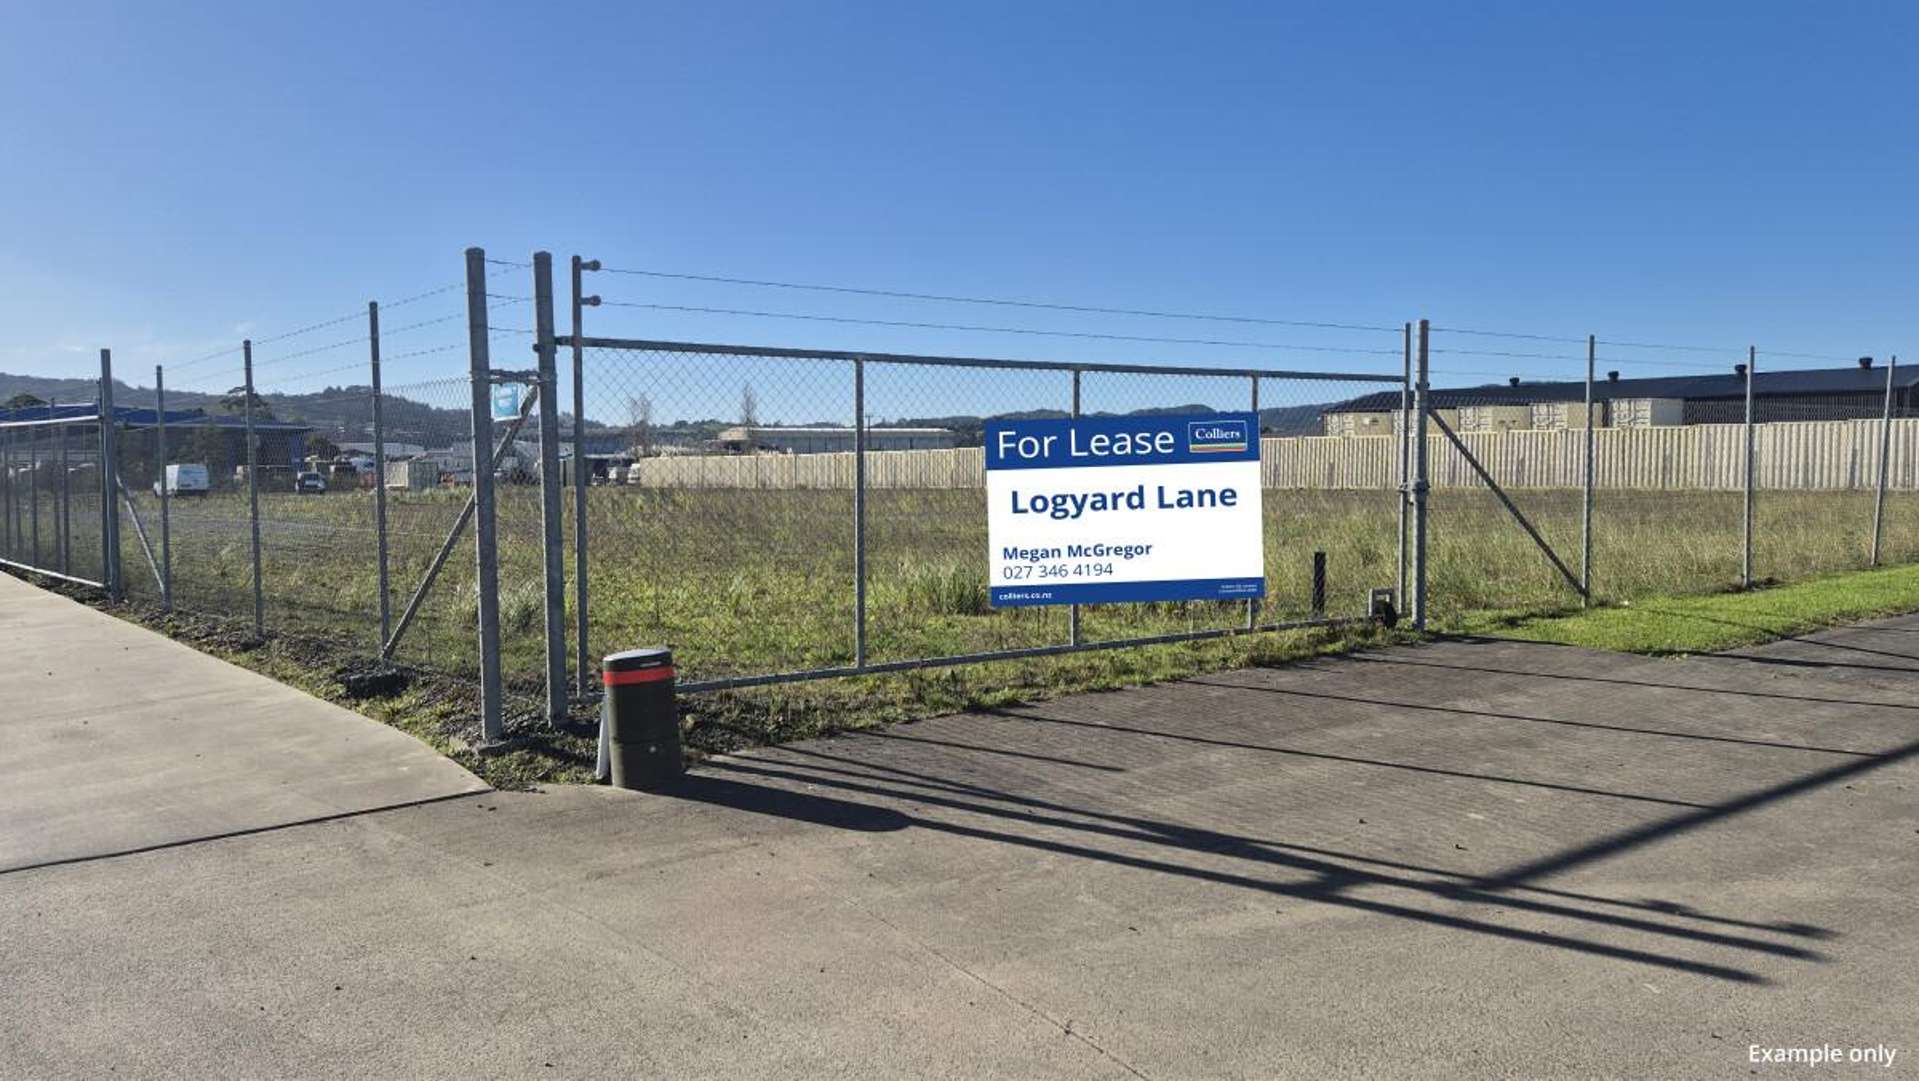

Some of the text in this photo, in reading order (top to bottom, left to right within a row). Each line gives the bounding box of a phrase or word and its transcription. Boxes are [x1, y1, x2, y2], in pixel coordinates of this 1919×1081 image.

[1195, 427, 1241, 439] Colliers
[998, 428, 1175, 459] For Lease
[1011, 485, 1238, 520] Logyard Lane
[1003, 543, 1153, 563] Megan McGregor
[1003, 562, 1113, 580] 027 346 4194
